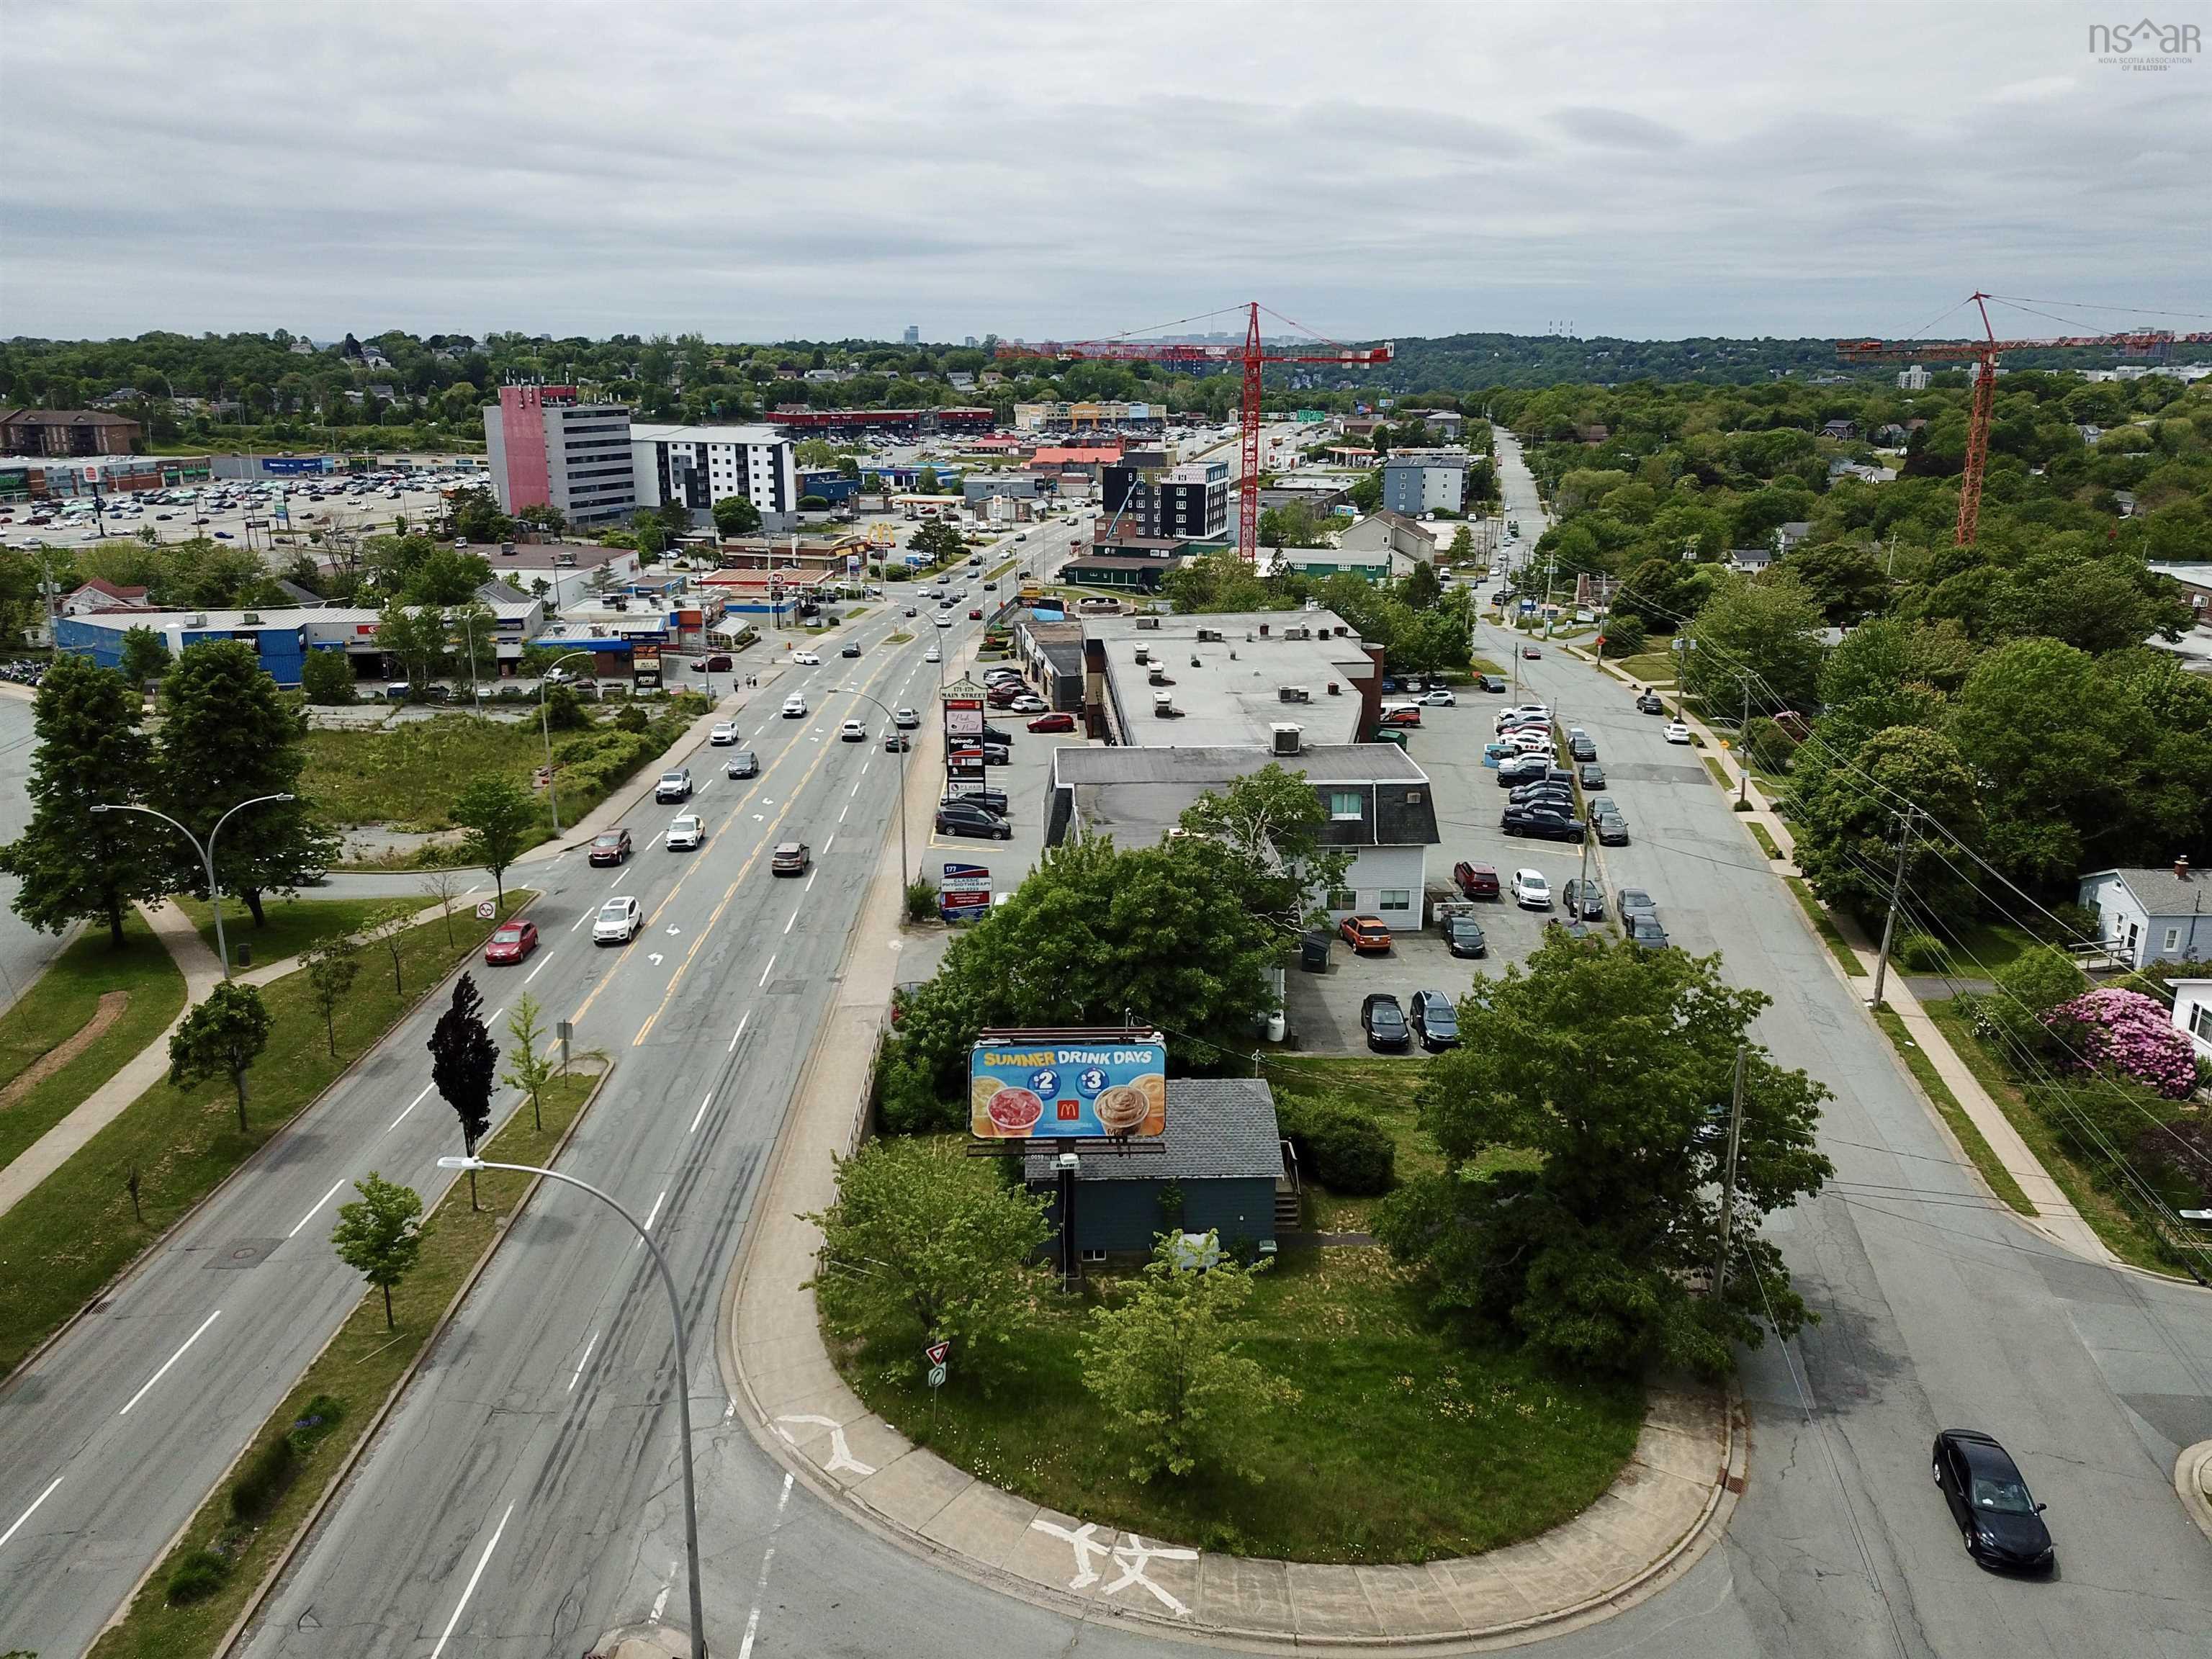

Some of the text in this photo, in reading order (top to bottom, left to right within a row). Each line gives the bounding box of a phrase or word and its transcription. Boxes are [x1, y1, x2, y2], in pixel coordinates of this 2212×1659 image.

[984, 1051, 1152, 1066] SUMMER DRINK DAYS
